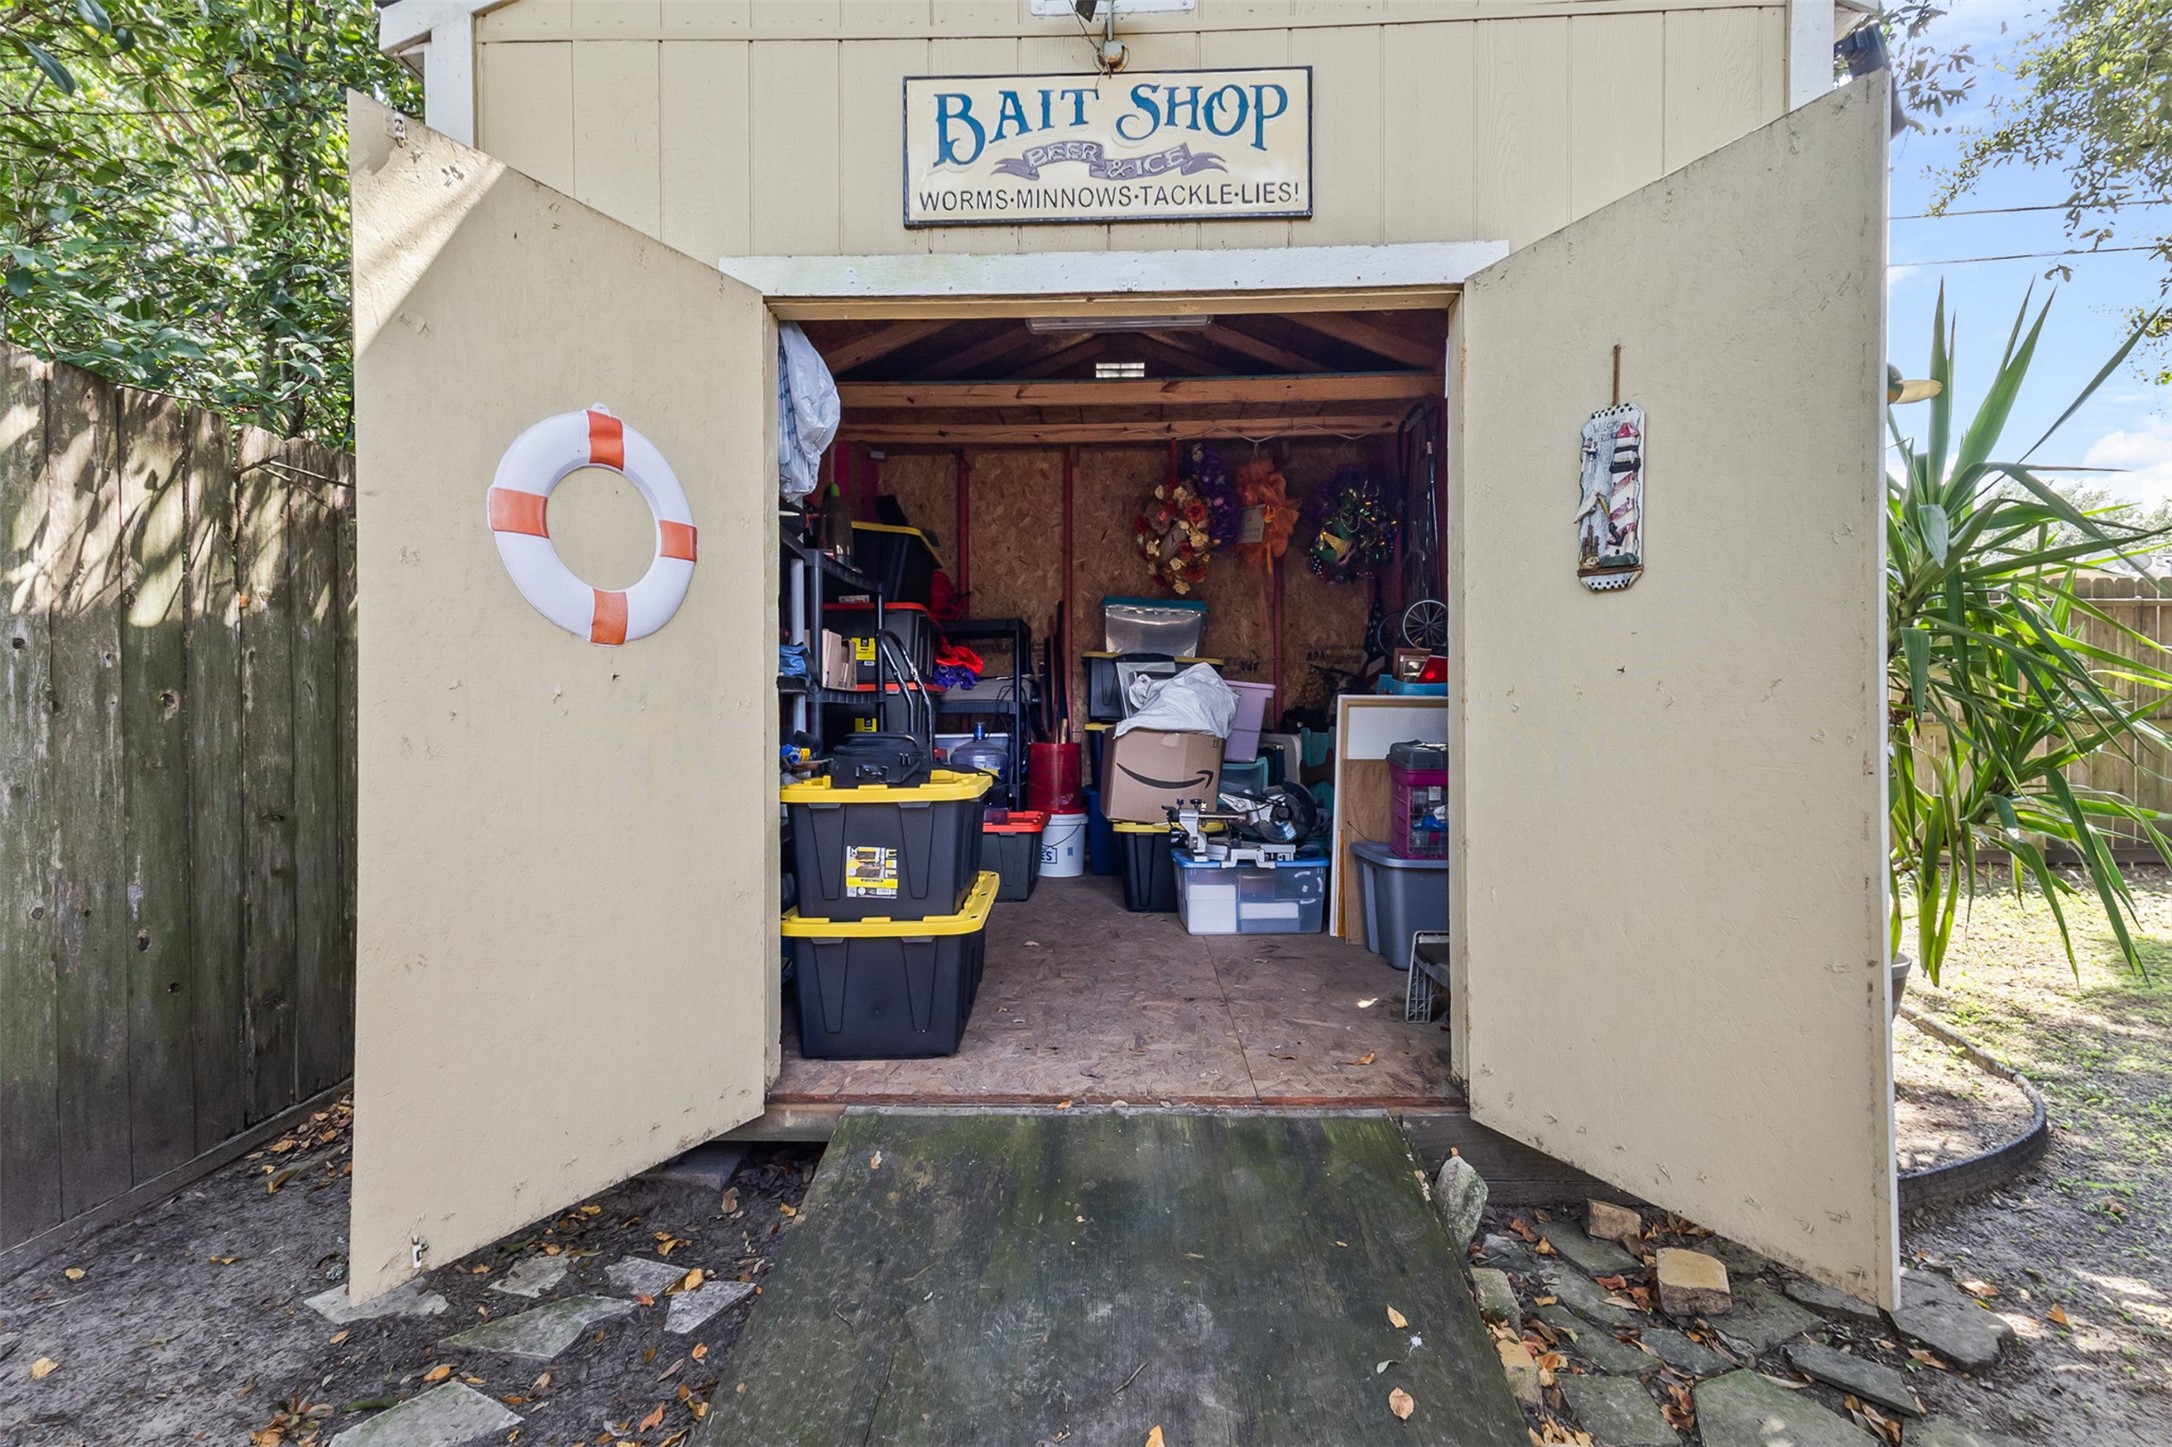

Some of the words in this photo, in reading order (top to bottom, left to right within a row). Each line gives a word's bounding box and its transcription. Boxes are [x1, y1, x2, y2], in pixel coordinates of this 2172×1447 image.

[934, 89, 1099, 168] BAIT
[1115, 83, 1289, 152] SHOP
[1027, 142, 1099, 166] BEER
[1108, 161, 1133, 178] &
[1137, 148, 1185, 174] ICE
